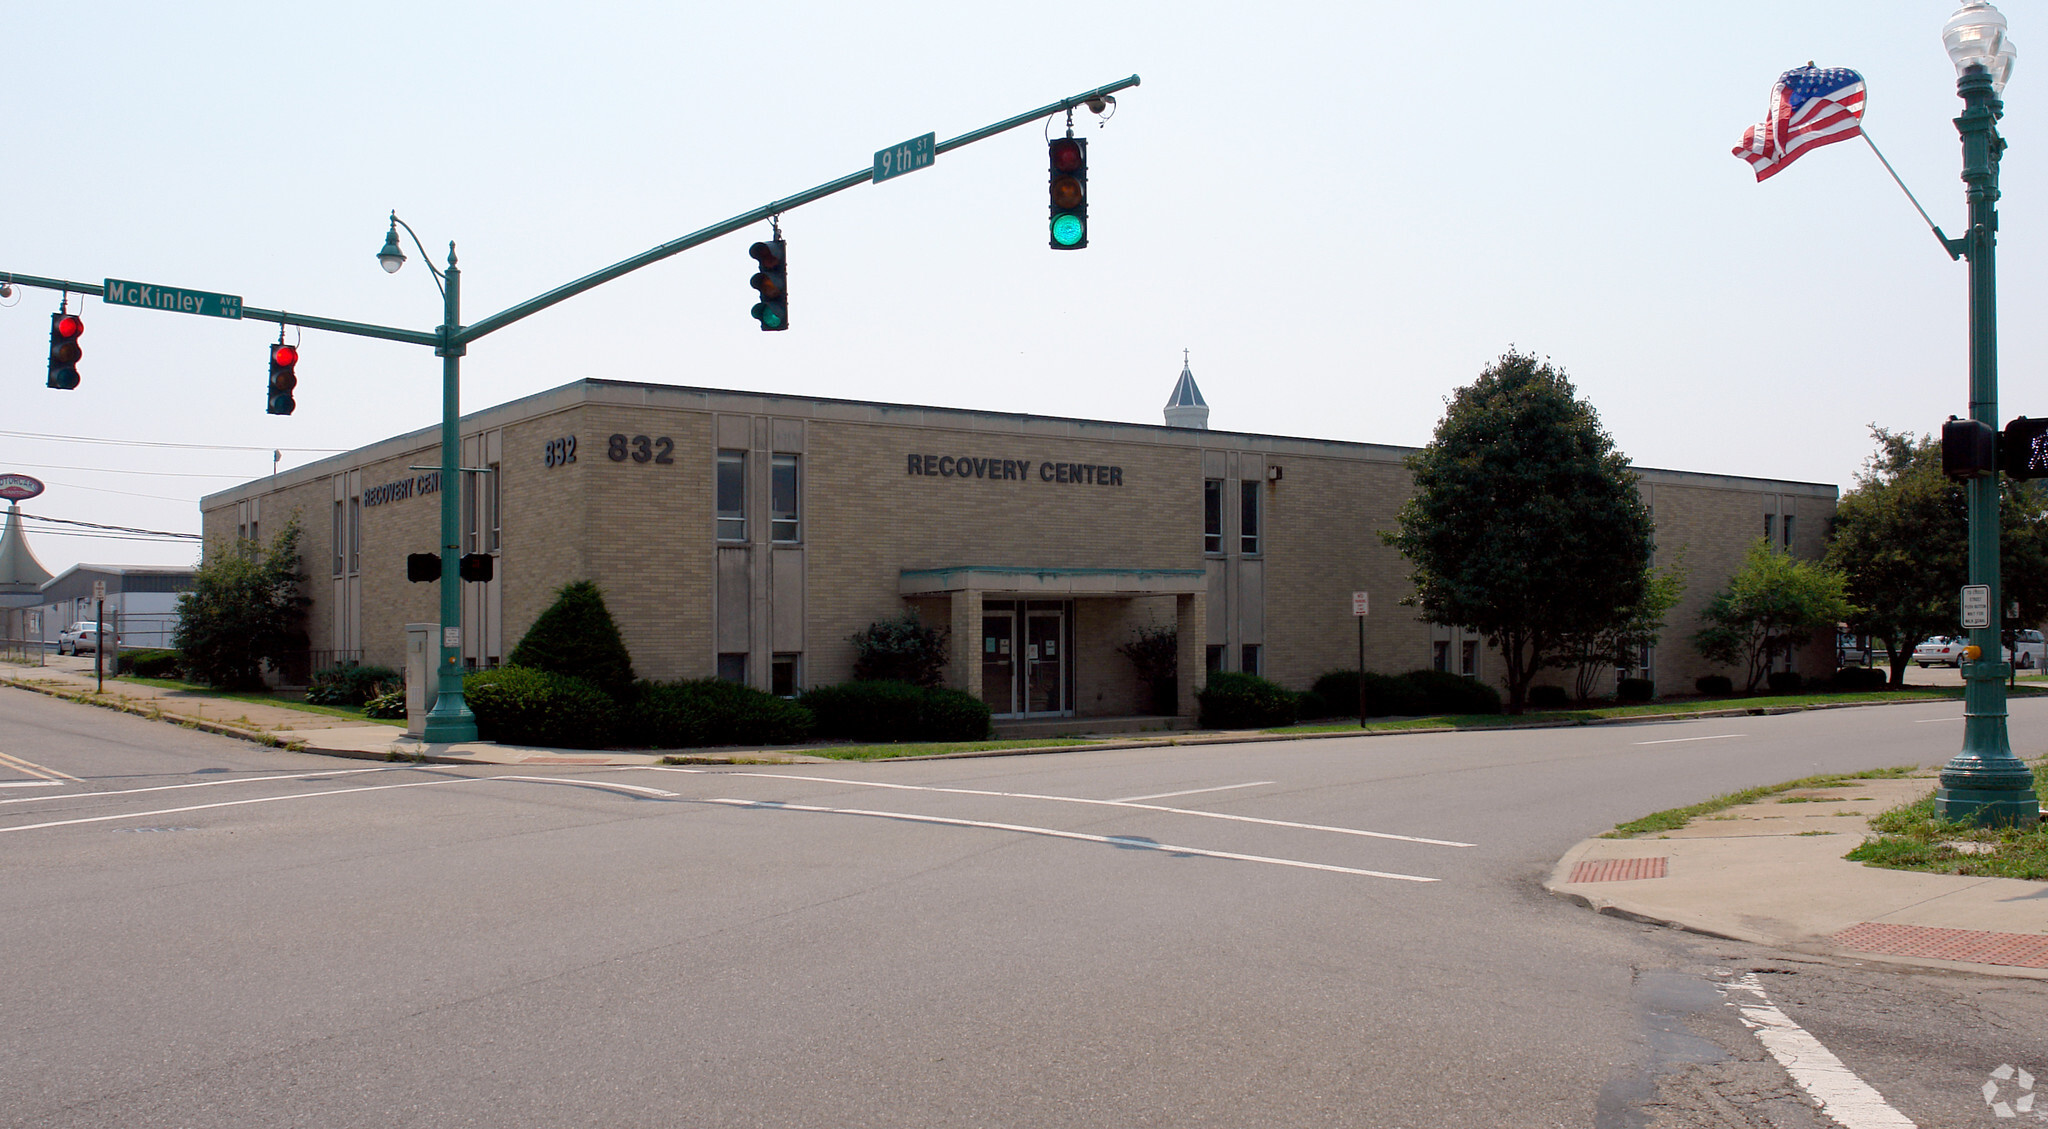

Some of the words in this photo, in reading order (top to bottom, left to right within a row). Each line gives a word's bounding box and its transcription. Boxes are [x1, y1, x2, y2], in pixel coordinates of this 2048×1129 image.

[916, 152, 928, 166] NW
[917, 138, 928, 151] ST
[108, 281, 204, 314] McKinley
[220, 296, 238, 307] AVE
[221, 307, 236, 317] NW
[544, 434, 577, 468] 832
[608, 433, 675, 465] 832
[907, 453, 1031, 481] RECOVERY
[1039, 461, 1123, 487] CENTER
[363, 477, 414, 508] RECOVERY
[417, 471, 443, 497] CENT
